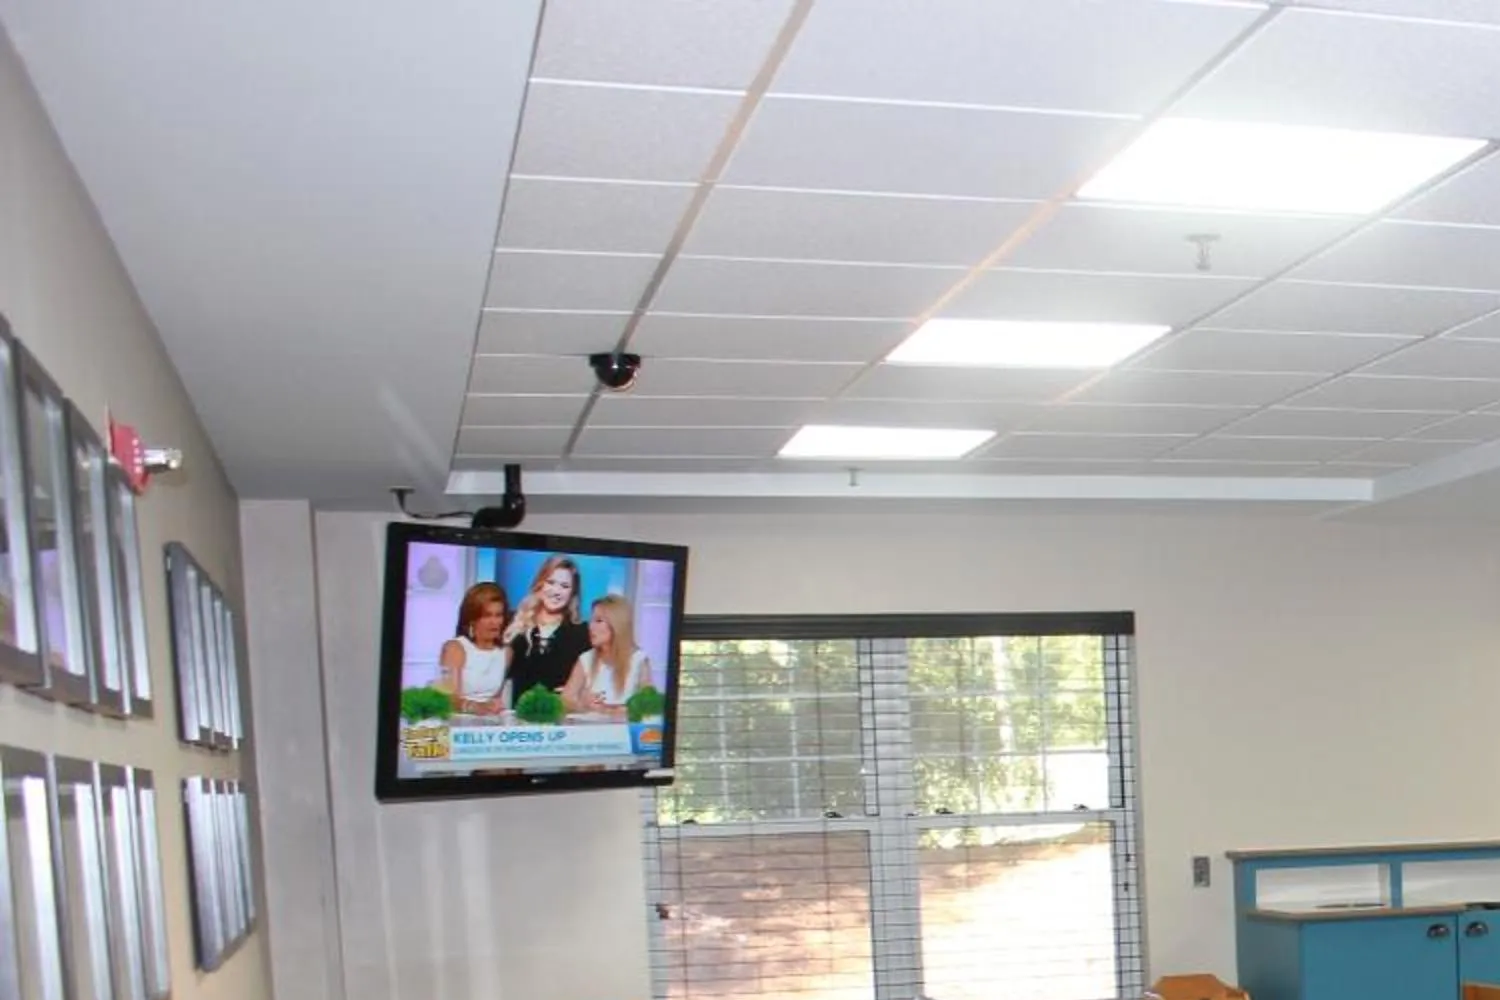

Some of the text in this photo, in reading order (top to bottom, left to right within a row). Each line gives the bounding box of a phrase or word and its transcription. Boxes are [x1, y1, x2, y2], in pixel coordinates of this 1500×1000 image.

[453, 731, 493, 745] KELLY
[499, 731, 544, 744] OPENS
[548, 730, 567, 743] UP
